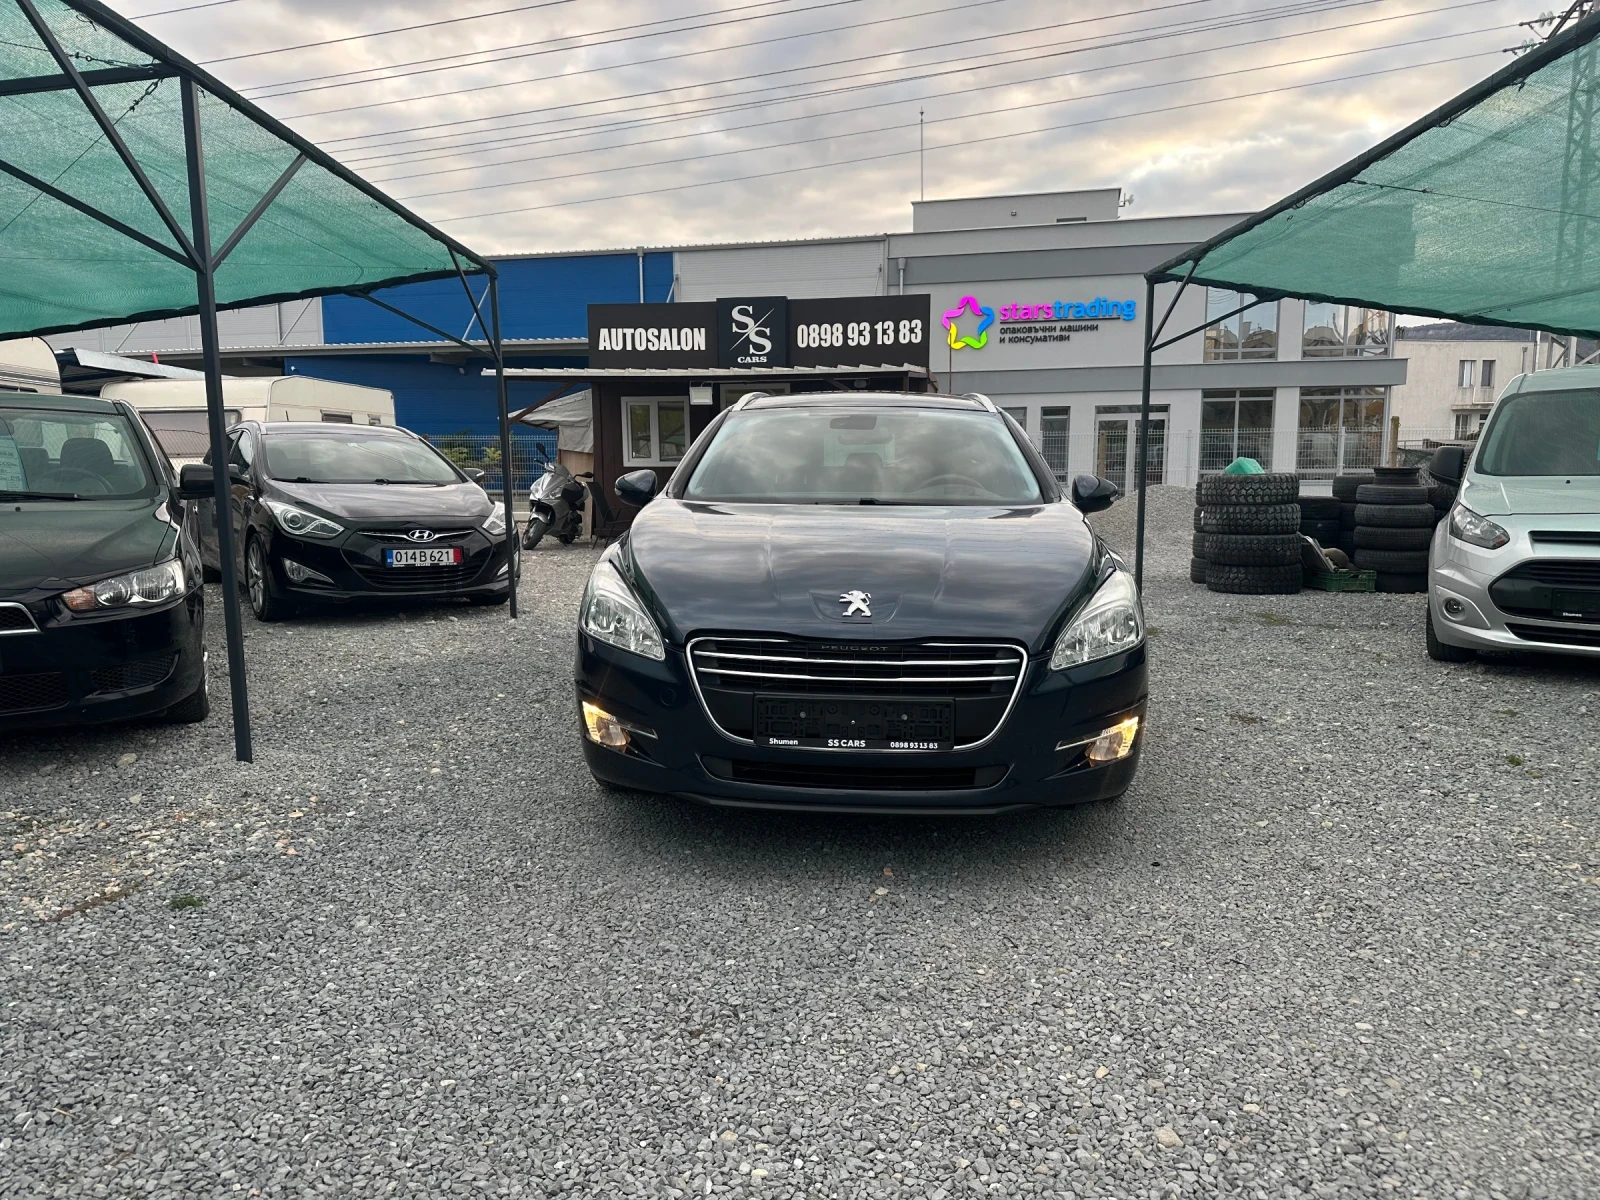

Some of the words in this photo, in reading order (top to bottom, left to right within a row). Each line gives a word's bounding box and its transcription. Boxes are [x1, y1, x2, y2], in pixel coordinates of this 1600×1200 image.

[1000, 296, 1136, 321] starstrading
[797, 323, 843, 348] 0898
[847, 321, 870, 347] 93
[874, 320, 894, 345] 13
[898, 319, 922, 344] 83
[1000, 325, 1057, 335] опаковъчни
[1059, 323, 1099, 332] машини
[598, 327, 706, 351] AUTOSALON
[999, 336, 1006, 344] и
[1008, 334, 1070, 345] консумативи
[737, 356, 768, 364] CARS
[769, 737, 799, 745] Shumen
[828, 739, 840, 747] SS
[841, 739, 866, 748] CARS
